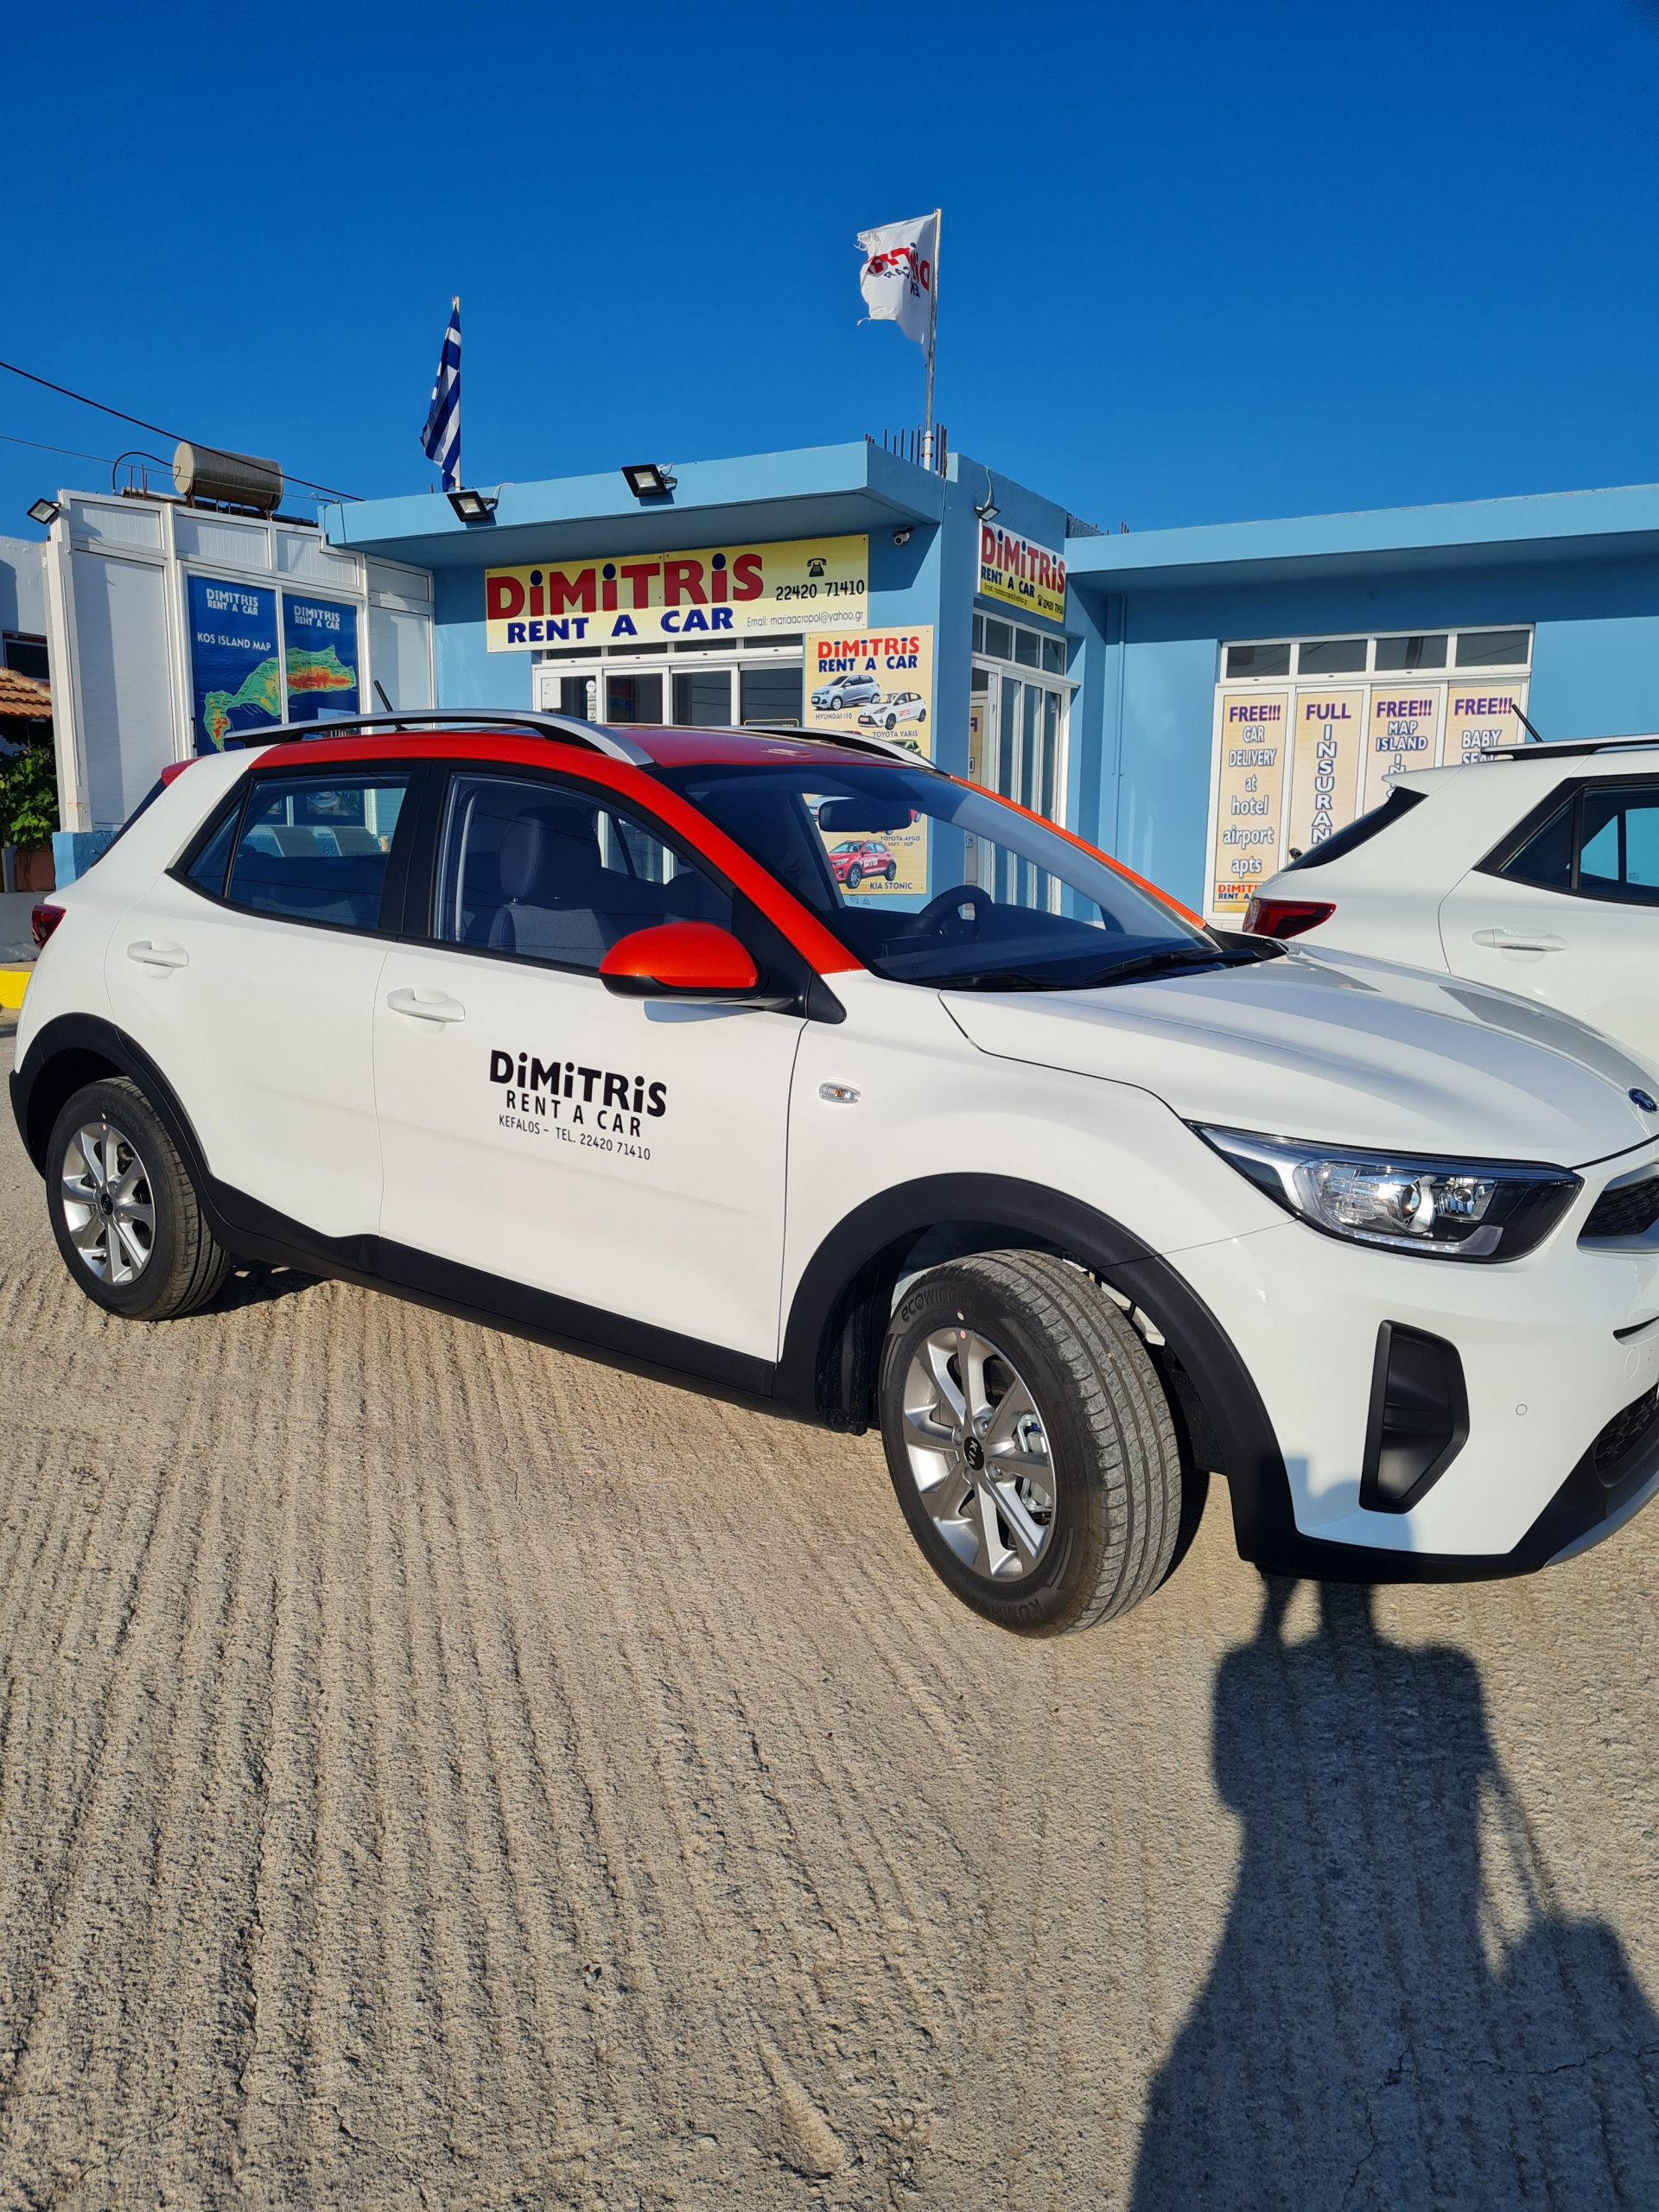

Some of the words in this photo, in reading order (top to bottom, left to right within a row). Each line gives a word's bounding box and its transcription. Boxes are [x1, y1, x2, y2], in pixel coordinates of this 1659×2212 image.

[981, 525, 1065, 594] DiMiTRiS
[486, 553, 764, 620] DiMiTRiS
[776, 583, 817, 601] 22420
[824, 579, 865, 597] 71410
[981, 565, 1002, 585] RENT
[1007, 576, 1014, 590] A
[1019, 581, 1034, 598] CAR
[207, 600, 227, 610] RENT
[232, 604, 238, 613] A
[242, 606, 258, 615] CAR
[295, 616, 313, 626] RENT
[326, 620, 340, 631] CAR
[507, 617, 589, 644] RENT
[611, 614, 638, 637] A
[660, 607, 734, 634] CAR
[747, 616, 768, 627] Email:
[197, 632, 215, 644] KOS
[218, 635, 250, 649] ISLAND
[252, 640, 271, 652] MAP
[817, 636, 919, 658] DiMiTRiS
[818, 658, 855, 672] RENT
[865, 656, 876, 671] A
[887, 655, 918, 670] CAR
[1230, 704, 1281, 722] FREE!!!
[1306, 703, 1351, 721] FULL
[1376, 700, 1433, 718] FREE!!!
[1454, 696, 1513, 716] FREE!!!
[1243, 726, 1265, 743] CAR
[1388, 720, 1418, 735] MAP
[1376, 736, 1428, 752] ISLAND
[1462, 729, 1503, 749] BABY
[1229, 748, 1277, 766] DELIVERY
[1245, 774, 1257, 791] at
[1311, 724, 1338, 845] INSURAN
[1230, 795, 1268, 815] hotel
[1223, 824, 1274, 849] airport
[1231, 856, 1262, 879] apts
[1217, 884, 1258, 893] DiMiT
[490, 1049, 667, 1117] DiMiTRiS
[506, 1090, 561, 1119] RENT
[573, 1104, 584, 1125] A
[597, 1109, 641, 1138] CAR
[499, 1114, 540, 1135] KEFALOS
[556, 1127, 575, 1143] TEL.
[580, 1133, 613, 1152] 22420
[617, 1141, 651, 1160] 71410
[968, 1440, 977, 1465] KIA
